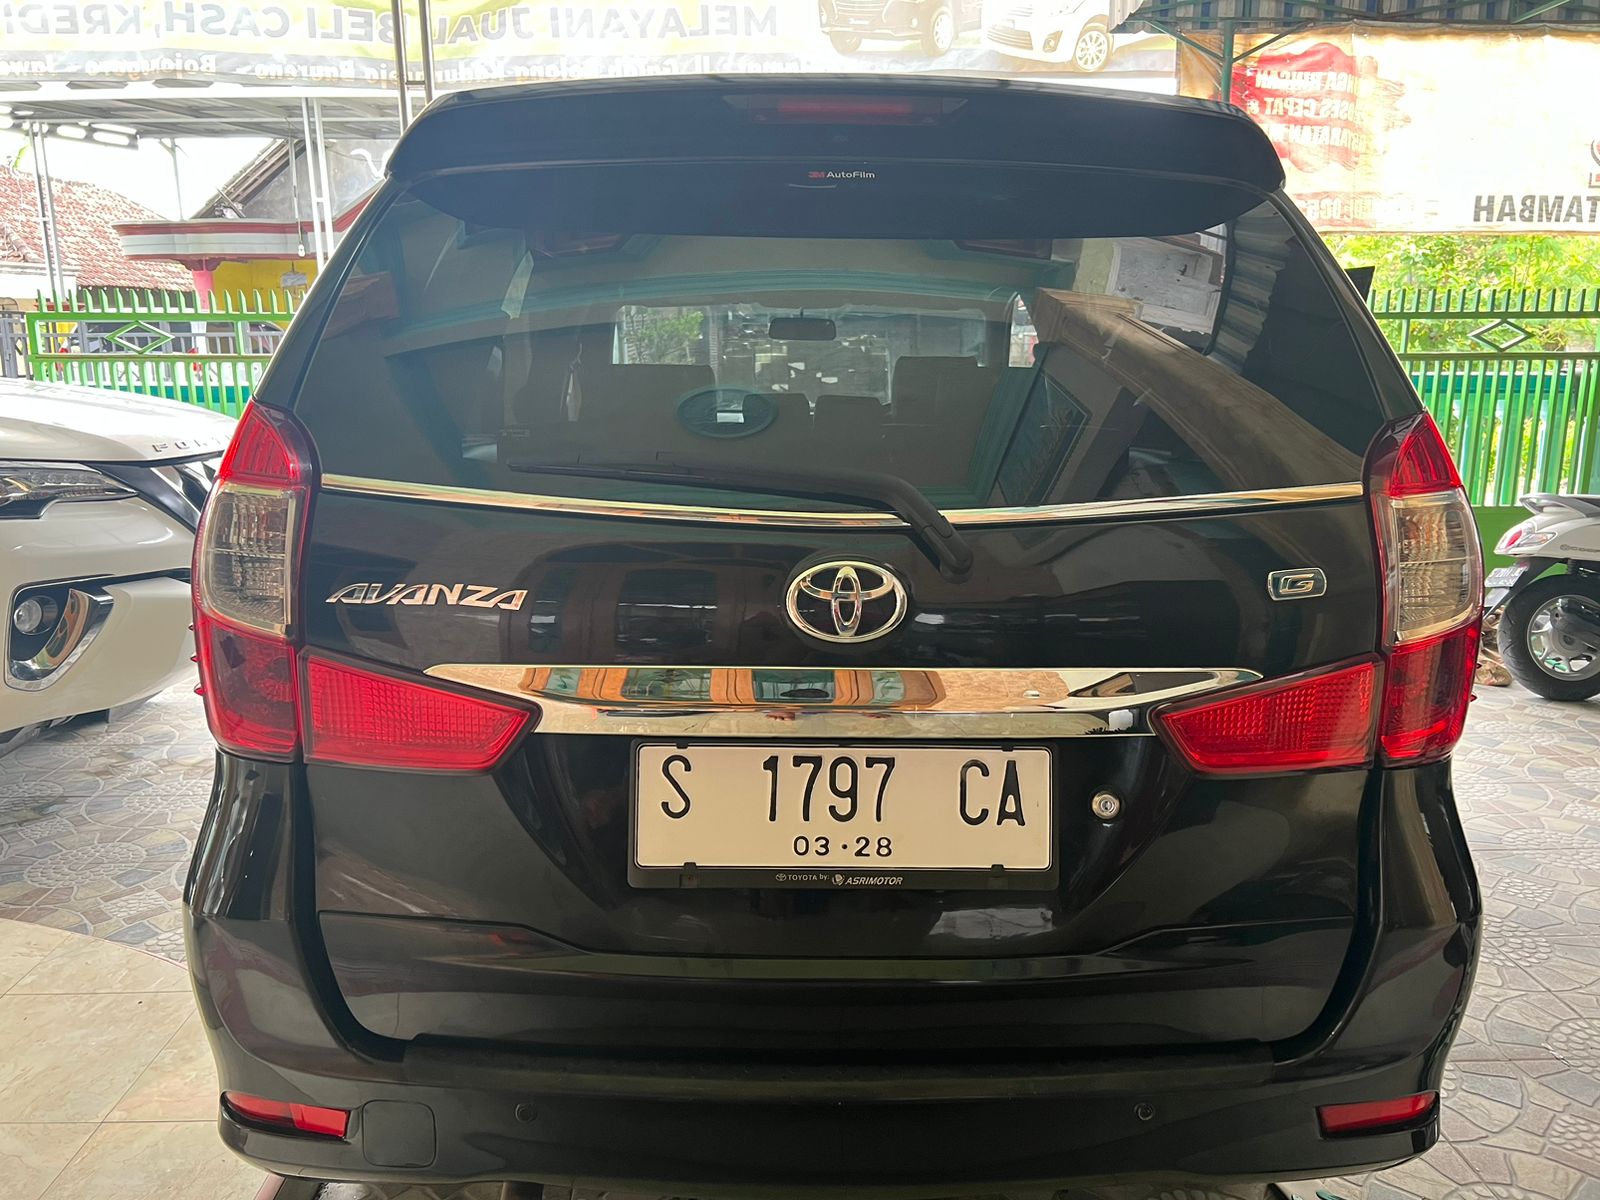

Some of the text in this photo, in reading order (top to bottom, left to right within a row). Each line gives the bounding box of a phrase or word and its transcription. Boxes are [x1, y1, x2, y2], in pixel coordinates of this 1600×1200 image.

[826, 171, 876, 179] AutoFilm
[325, 582, 529, 611] AVANZA
[660, 754, 1027, 827] S 1797 CA
[787, 873, 818, 882] TOYOTA
[844, 874, 904, 886] ASRIMOTOR
